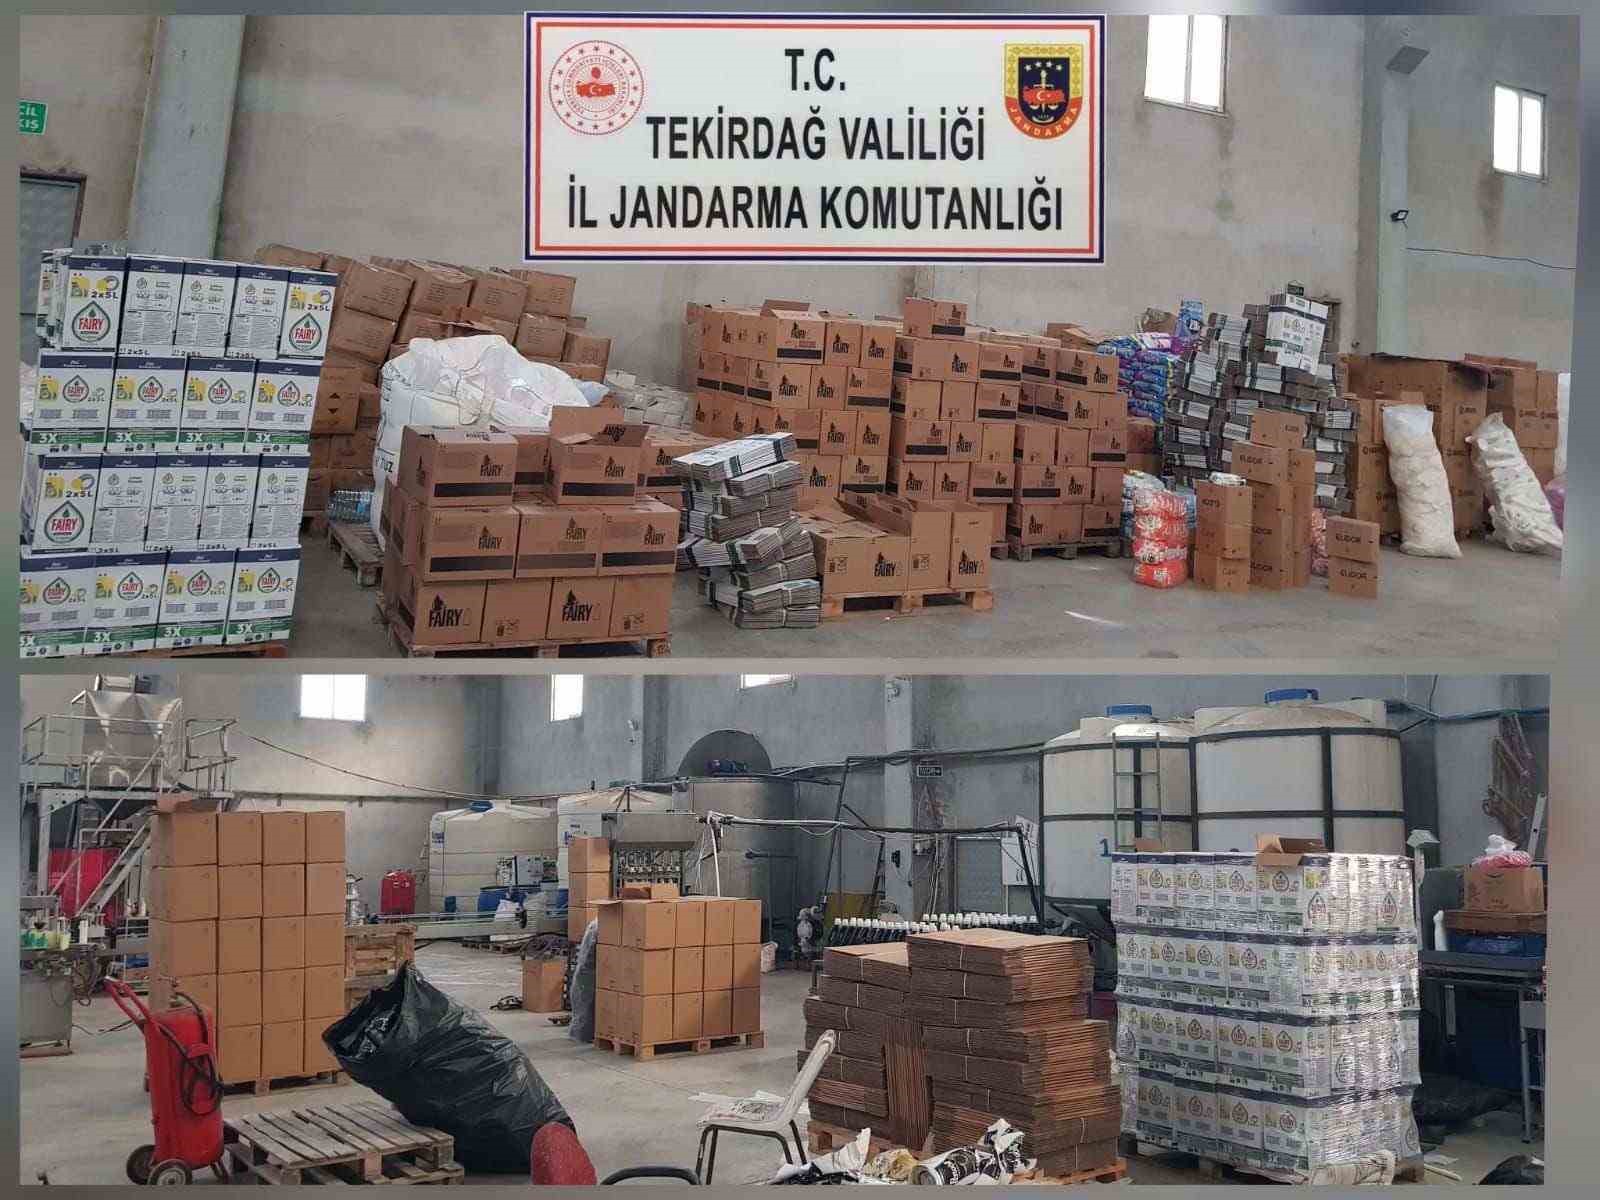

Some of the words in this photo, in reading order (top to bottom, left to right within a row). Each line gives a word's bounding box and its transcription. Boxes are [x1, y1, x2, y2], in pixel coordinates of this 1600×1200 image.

[78, 318, 105, 330] FAIRY
[294, 327, 316, 340] FAIRY
[832, 343, 850, 354] FAIRY
[778, 384, 798, 396] FAIRY
[816, 386, 834, 398] FAIRY
[480, 464, 504, 477] FAIRY
[604, 464, 626, 478] FAIRY
[51, 518, 79, 531] FAIRY
[566, 528, 587, 540] FAIRY
[644, 533, 666, 544] FAIRY
[478, 536, 503, 550] FAIRY
[874, 560, 896, 576] FAIRY
[958, 560, 979, 574] FAIRY
[122, 582, 140, 592] FAIRY
[429, 608, 464, 628] FAIRY
[561, 603, 593, 622] FAIRY
